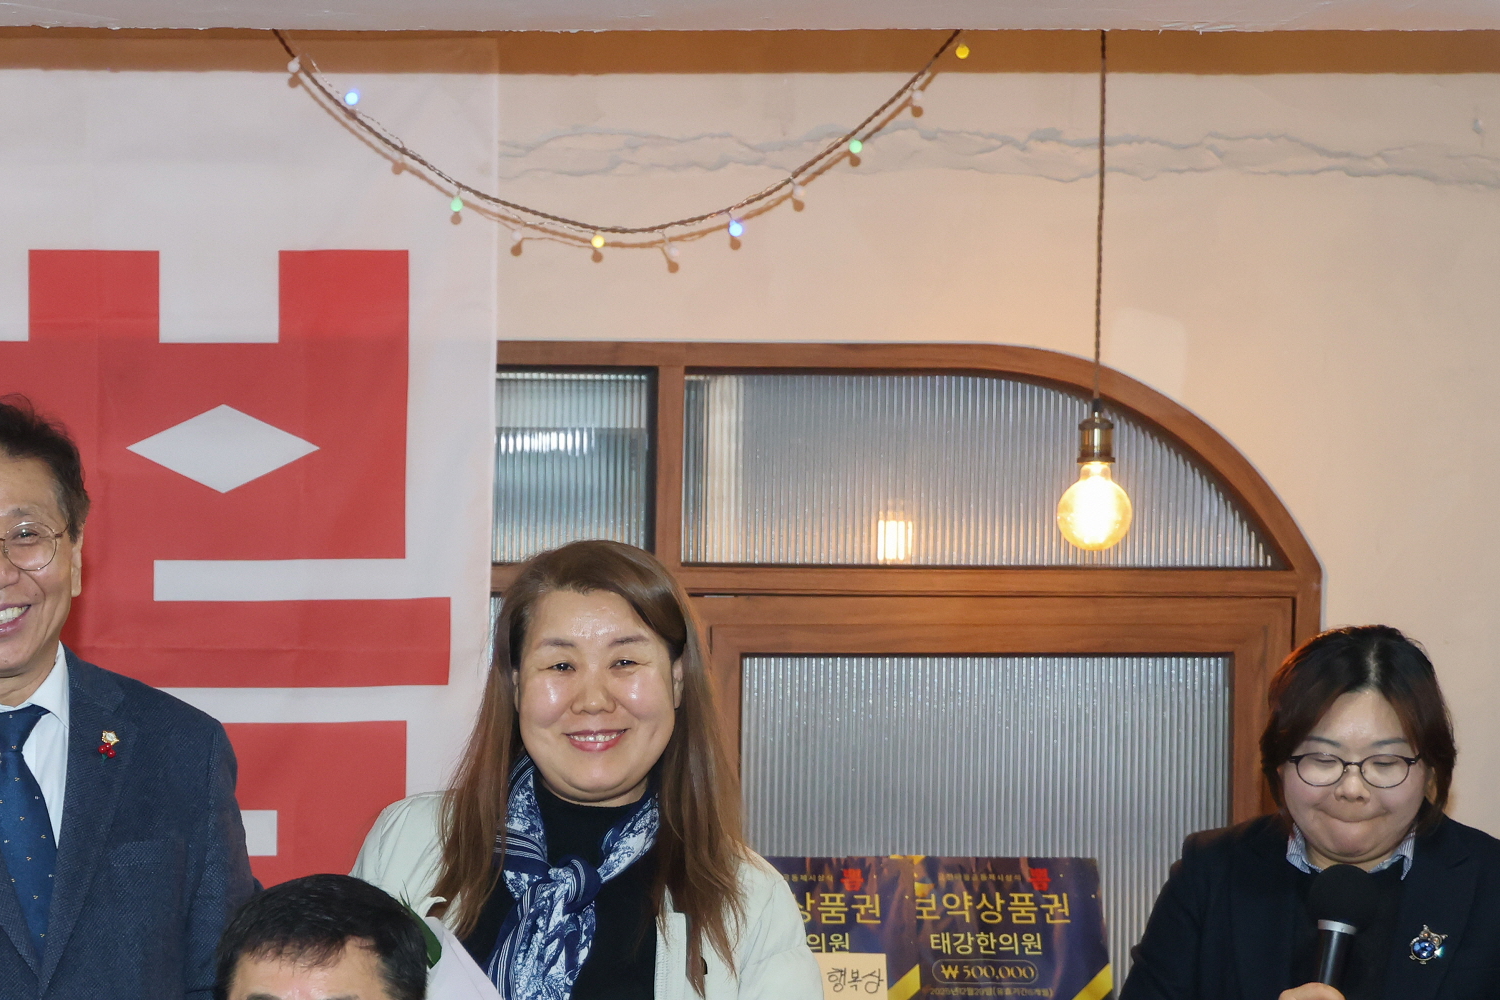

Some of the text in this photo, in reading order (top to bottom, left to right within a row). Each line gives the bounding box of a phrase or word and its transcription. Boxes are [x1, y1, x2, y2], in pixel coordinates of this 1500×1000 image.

[916, 892, 1072, 925] 보약상품권
[929, 932, 1043, 956] 태강한의원
[826, 967, 885, 994] 행복상
